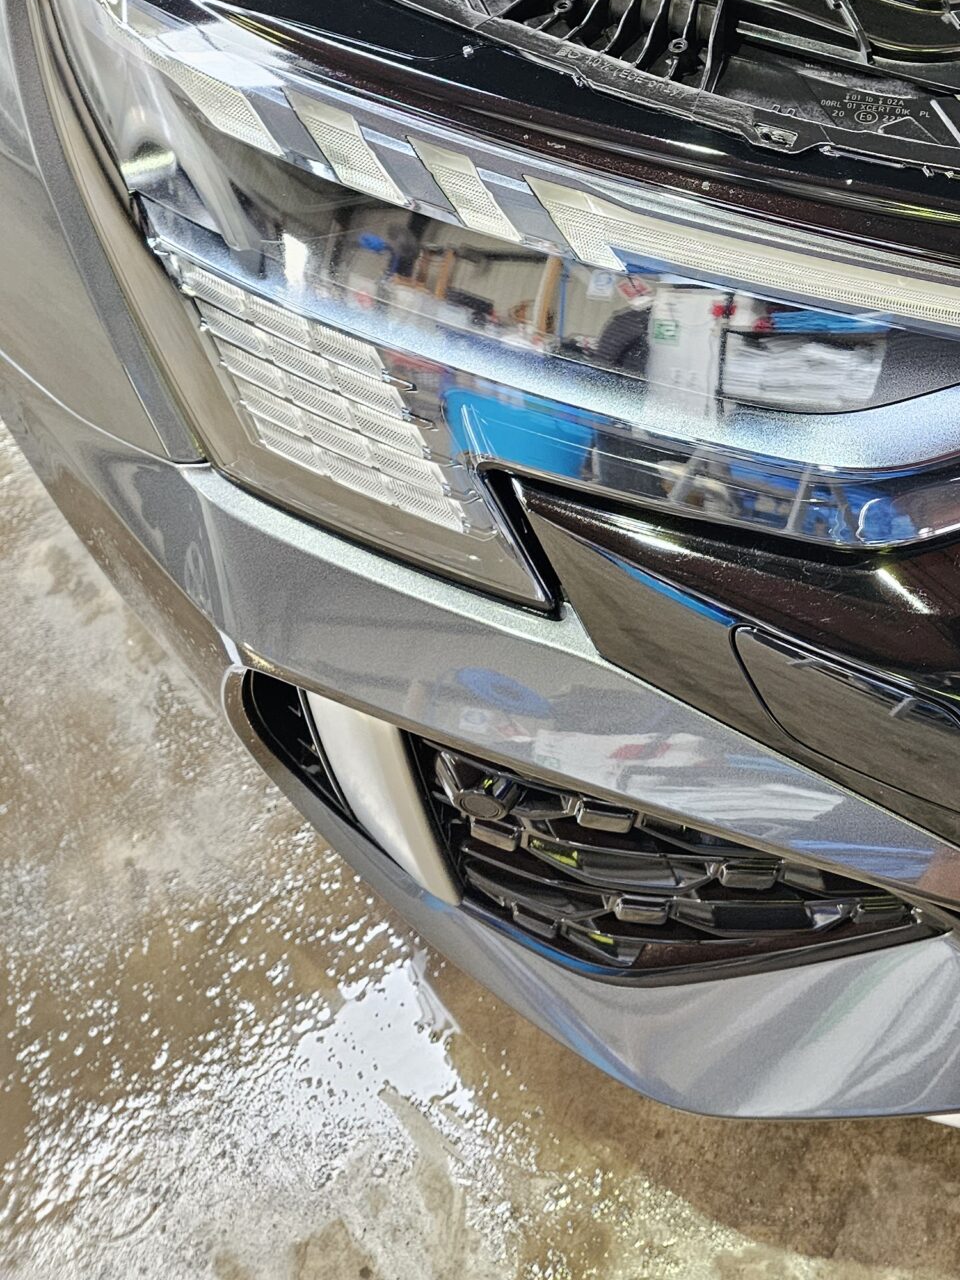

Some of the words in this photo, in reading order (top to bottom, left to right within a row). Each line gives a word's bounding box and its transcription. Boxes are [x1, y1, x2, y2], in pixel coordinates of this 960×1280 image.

[887, 98, 905, 106] 02A
[832, 109, 845, 117] 20
[859, 112, 873, 121] E9
[860, 104, 890, 113] XCERT
[919, 110, 931, 118] PL
